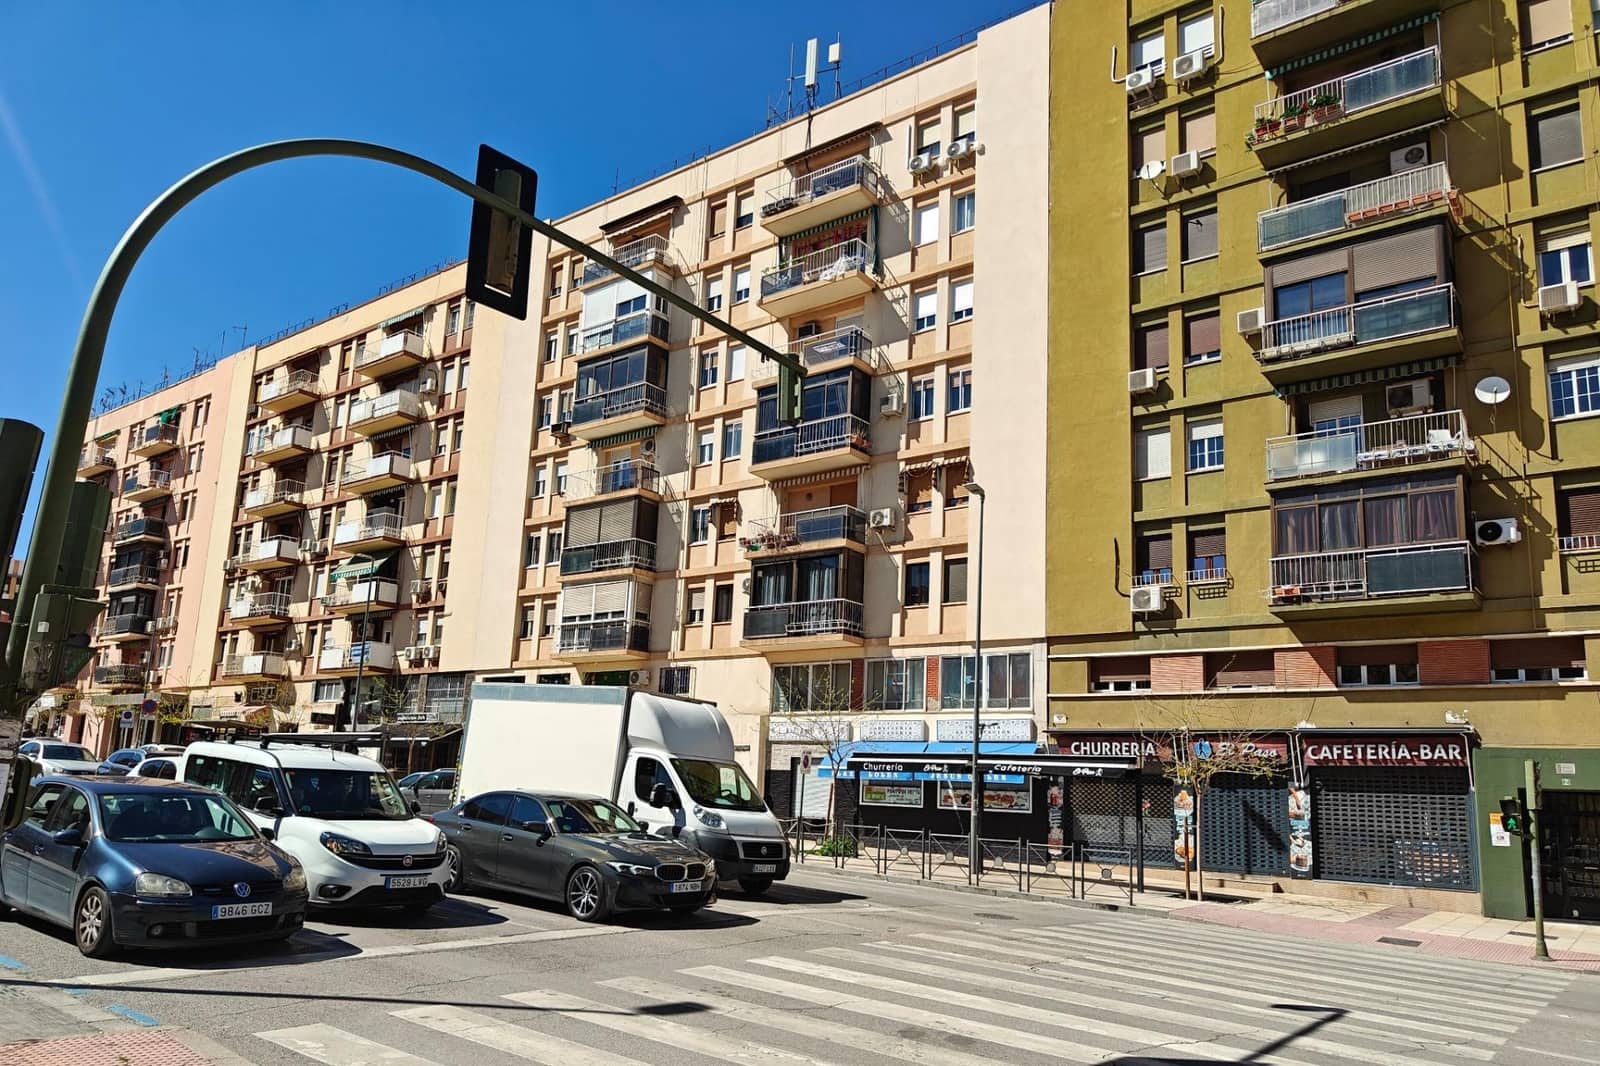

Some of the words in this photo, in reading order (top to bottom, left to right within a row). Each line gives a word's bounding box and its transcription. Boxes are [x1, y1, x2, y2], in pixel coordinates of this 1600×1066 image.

[1307, 741, 1462, 760] CAFETERÍA-BAR
[220, 905, 248, 917] 9846
[250, 903, 270, 915] GCZ
